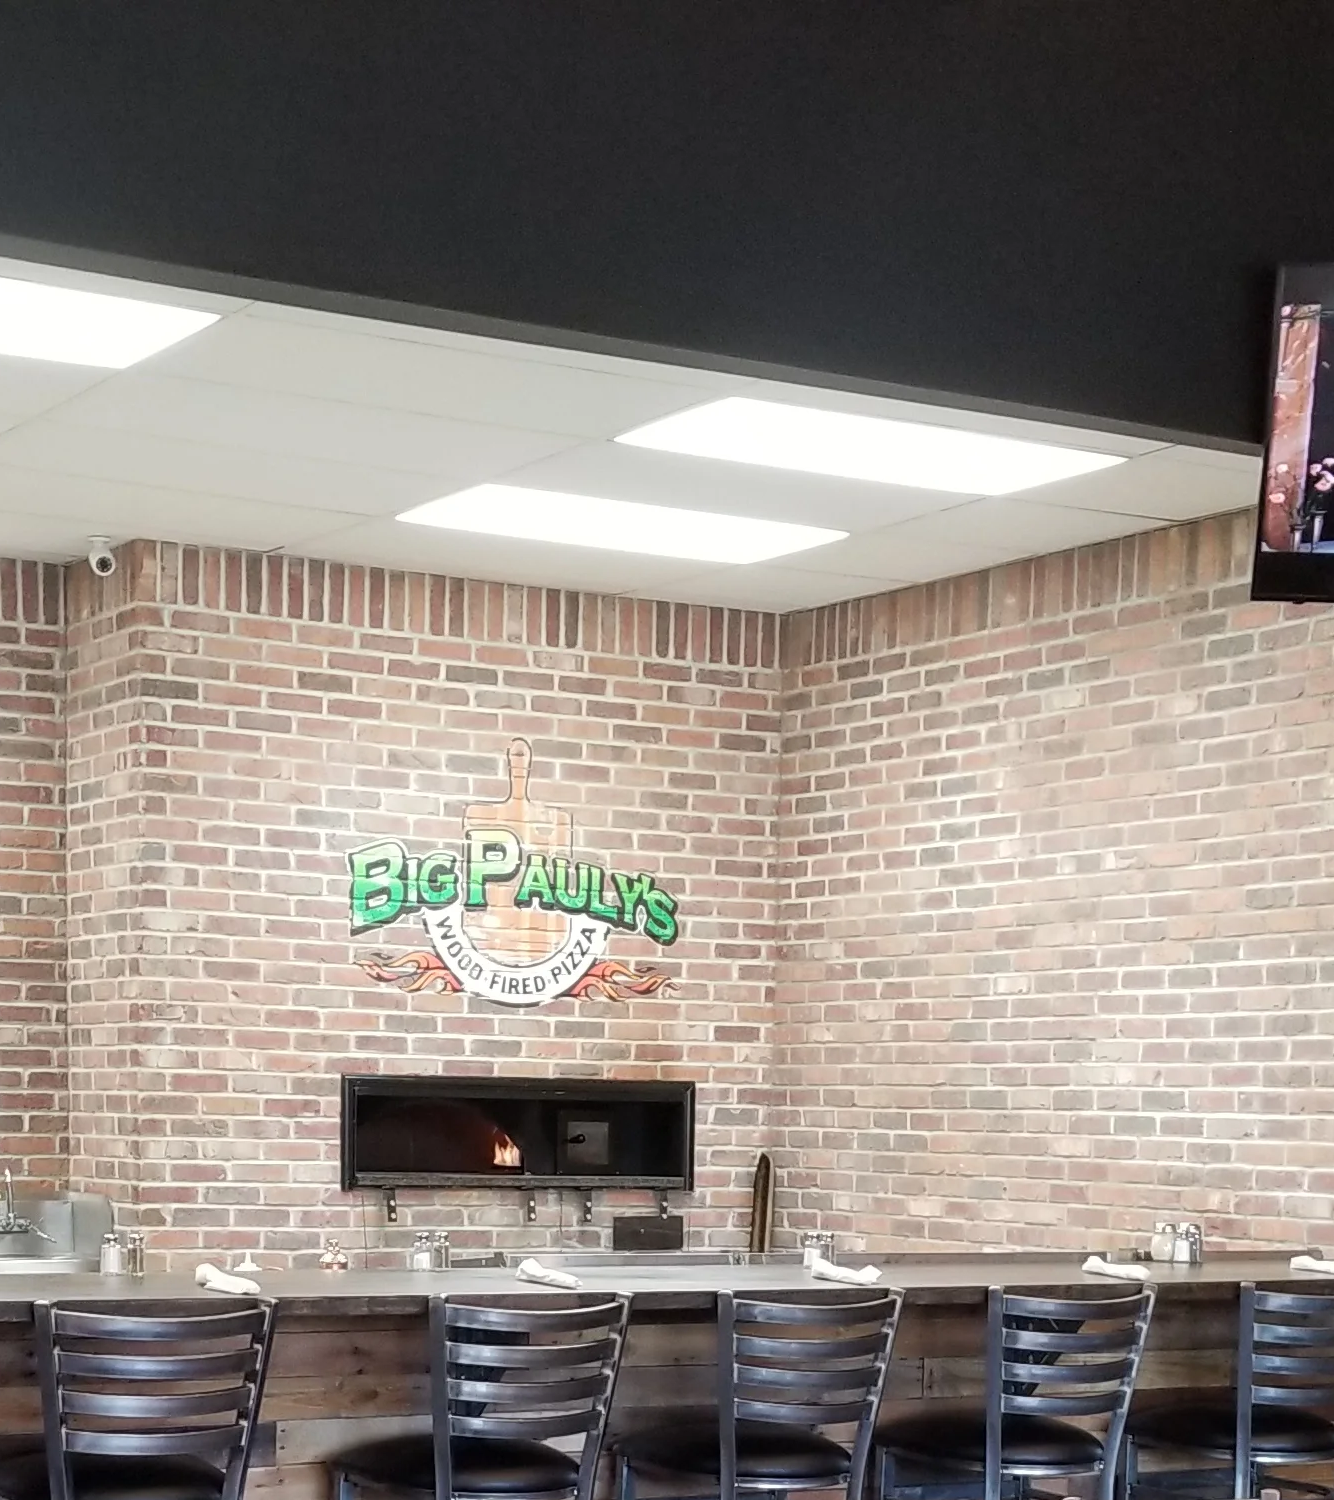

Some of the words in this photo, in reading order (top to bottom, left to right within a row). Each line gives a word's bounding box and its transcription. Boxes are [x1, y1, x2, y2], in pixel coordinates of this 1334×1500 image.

[463, 827, 679, 946] PAULY'S
[436, 915, 483, 982] WOOD
[489, 975, 546, 996] FIRED
[551, 927, 597, 986] PIZZA
